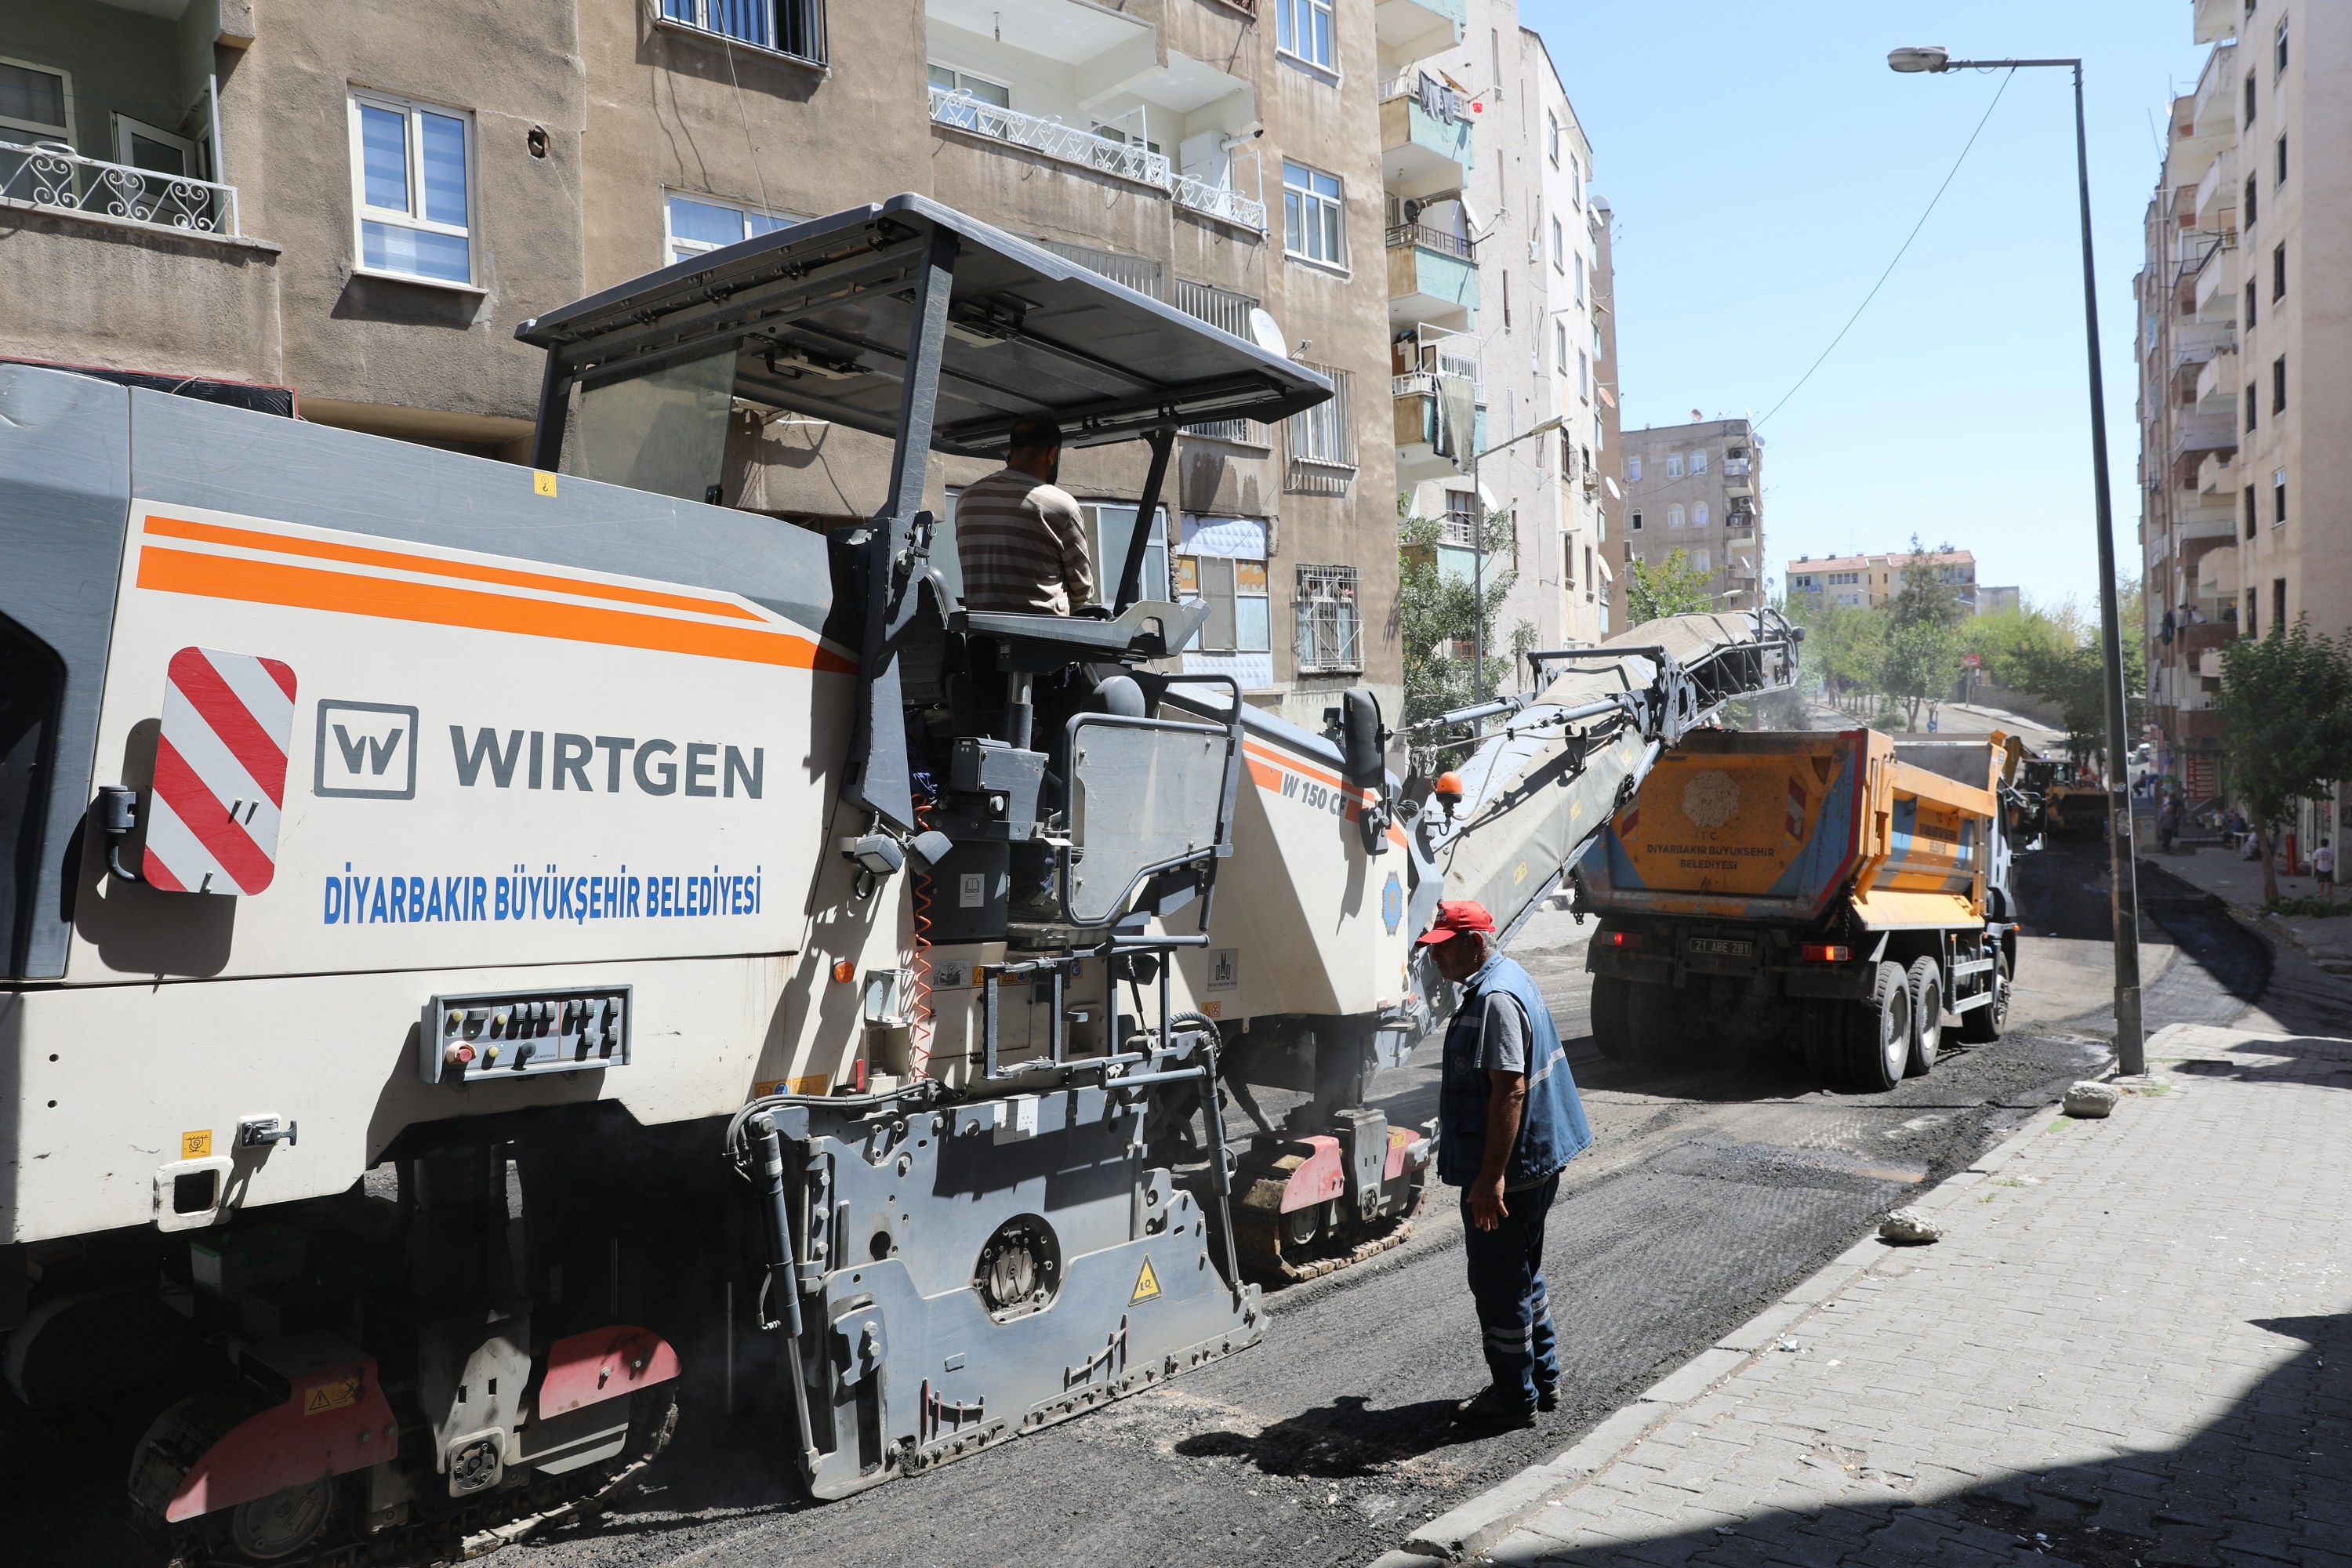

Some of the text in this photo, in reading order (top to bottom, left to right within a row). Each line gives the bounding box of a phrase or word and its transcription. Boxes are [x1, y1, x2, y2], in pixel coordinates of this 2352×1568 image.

[448, 724, 764, 800] WIRTGEN
[1283, 773, 1300, 799] W
[1301, 782, 1328, 810] 150
[324, 862, 762, 925] DİYARBAKIR BÜYÜKŞEHİR BELEDİYESİ
[1695, 940, 1707, 951] 21
[1732, 942, 1749, 954] 281
